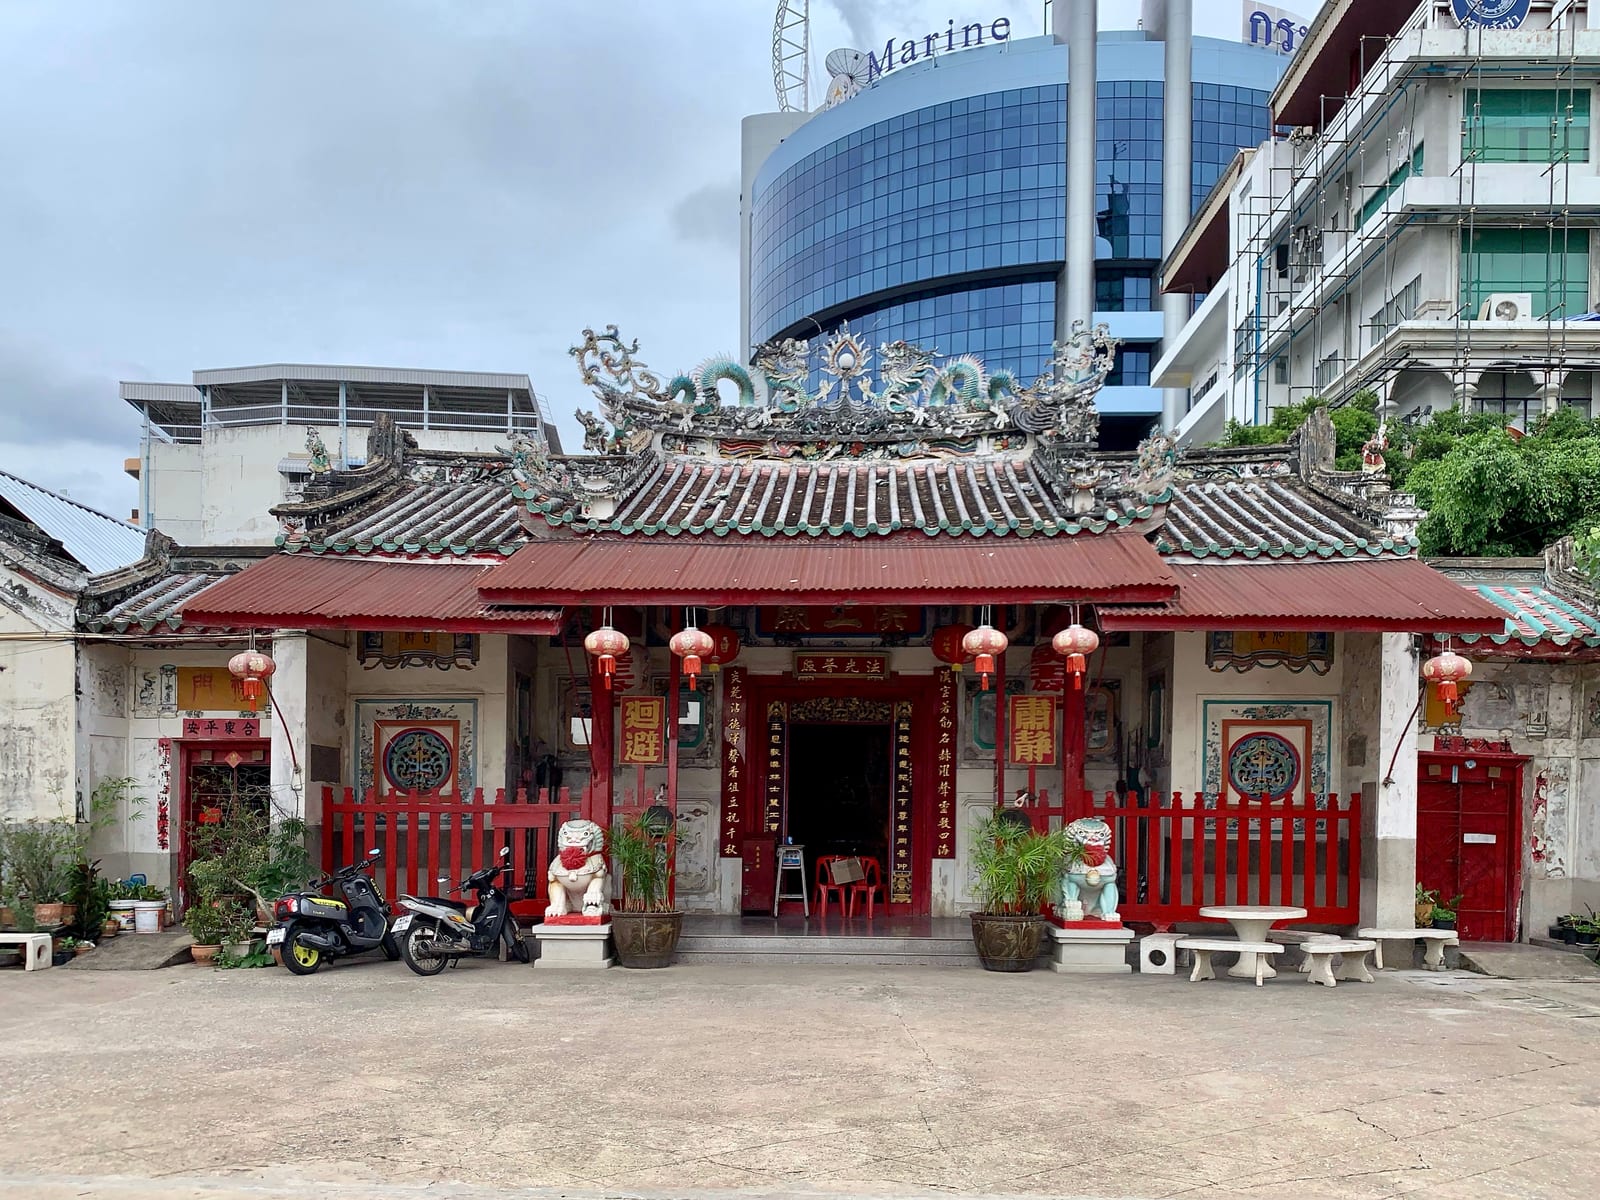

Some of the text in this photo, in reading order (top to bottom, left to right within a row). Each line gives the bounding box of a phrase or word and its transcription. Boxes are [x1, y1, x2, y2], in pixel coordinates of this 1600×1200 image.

[866, 17, 1010, 84] Marine
[1249, 11, 1308, 52] กร
[1014, 698, 1053, 763] 肅靜
